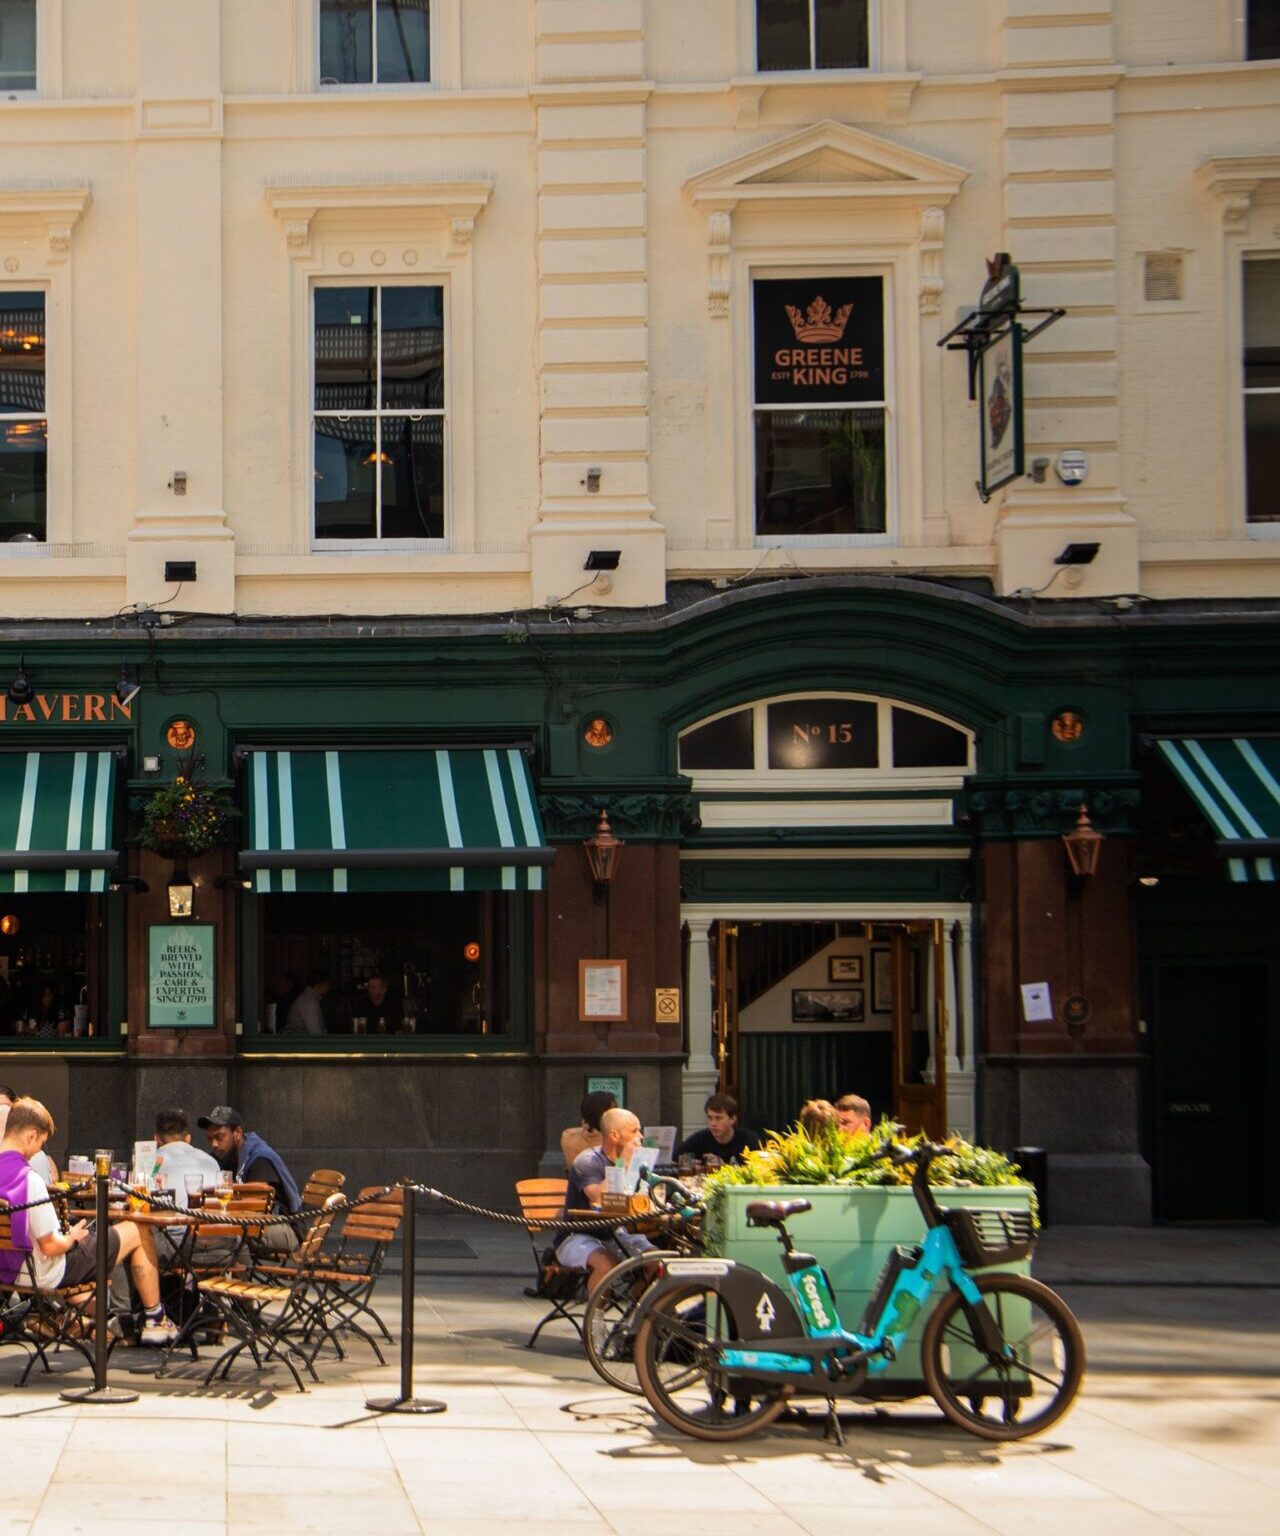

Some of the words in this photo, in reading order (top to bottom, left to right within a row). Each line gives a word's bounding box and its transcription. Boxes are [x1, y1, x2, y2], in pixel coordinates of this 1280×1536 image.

[775, 348, 863, 366] GREENE
[793, 367, 847, 385] KING
[829, 723, 853, 744] 15
[166, 945, 197, 953] BEERS
[161, 953, 202, 961] BREWED
[168, 962, 195, 970] WITH
[160, 970, 204, 979] PASSION,
[164, 978, 188, 986] CARE
[156, 986, 207, 995] EXPERTISE
[156, 995, 185, 1003] SINCE
[186, 995, 207, 1003] 1799
[802, 1274, 831, 1329] forest
